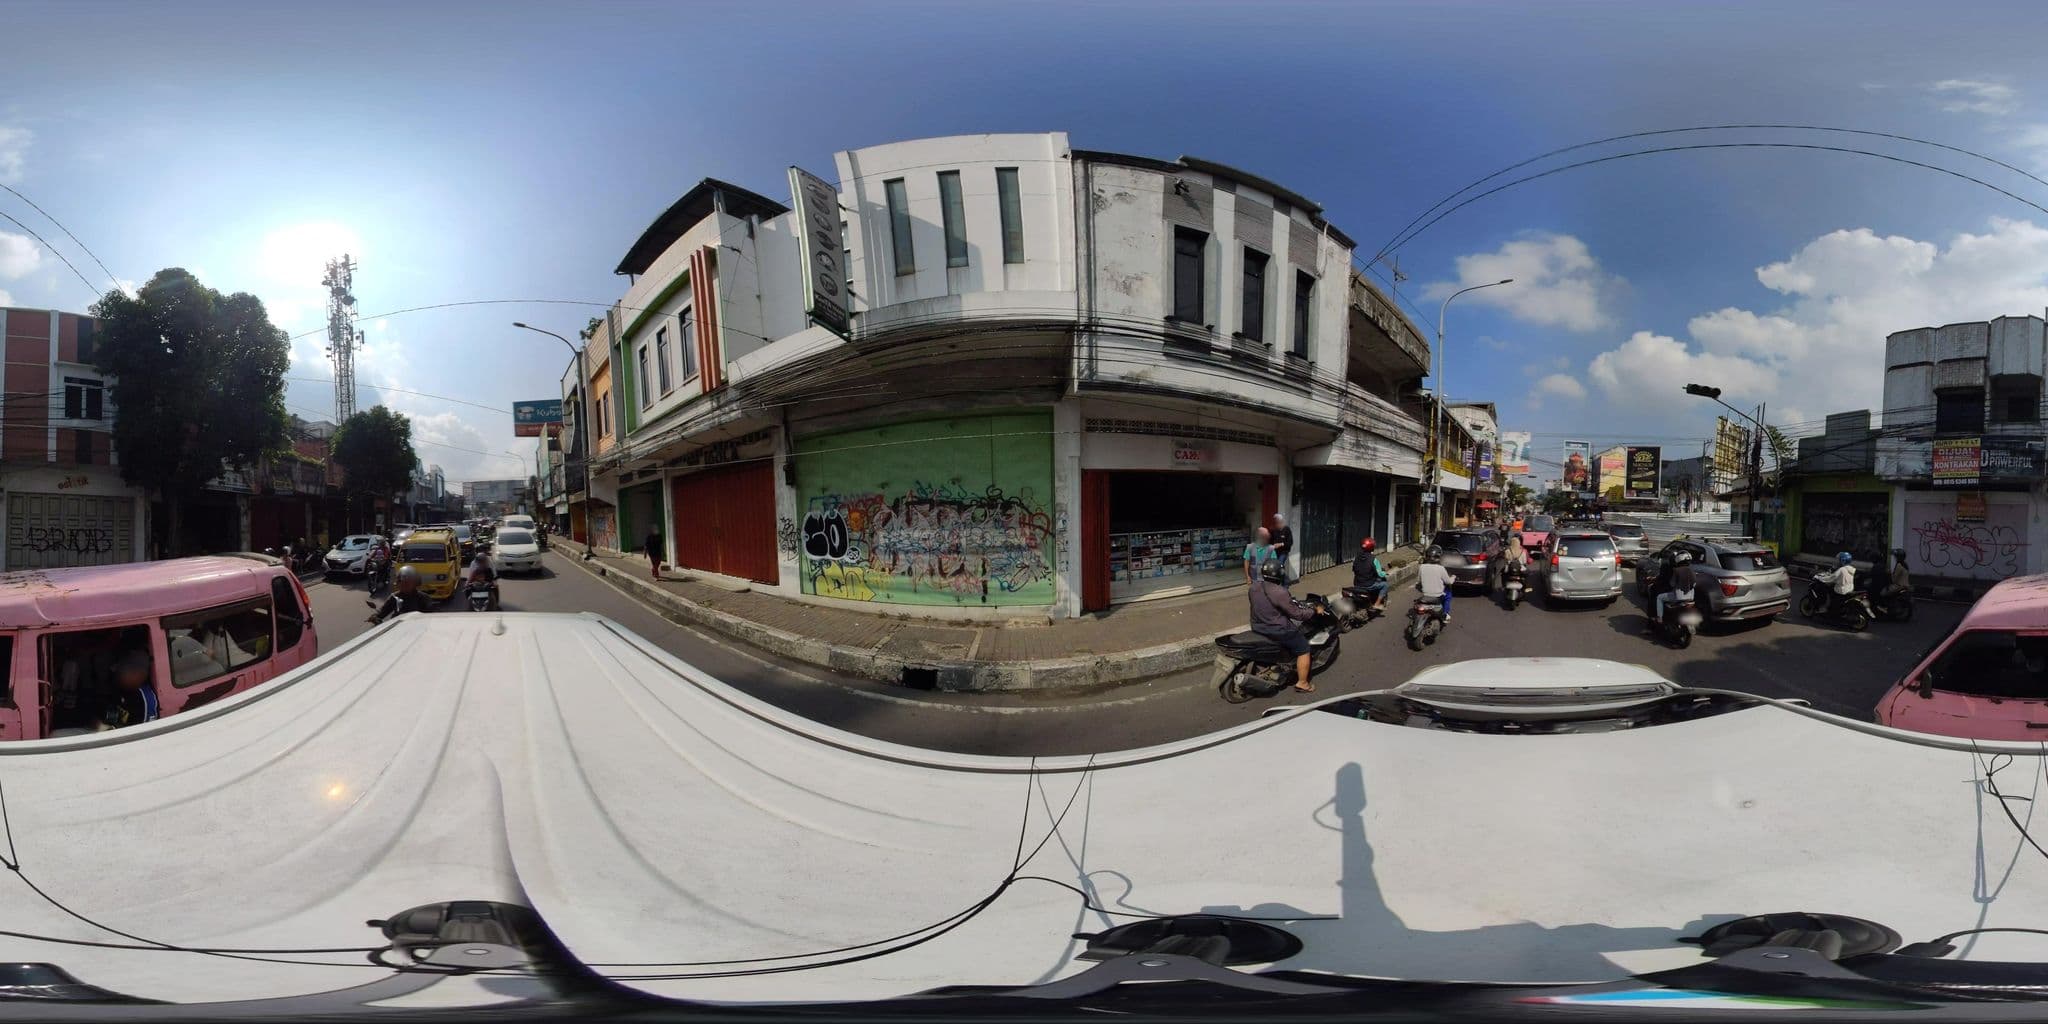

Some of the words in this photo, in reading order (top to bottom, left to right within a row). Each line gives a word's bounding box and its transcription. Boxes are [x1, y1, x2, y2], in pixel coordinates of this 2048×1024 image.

[536, 408, 561, 416] Kubo
[1938, 448, 1974, 456] DIJUAL
[1934, 460, 1979, 469] KONTRAKAN
[1990, 456, 2033, 469] POWERFUL
